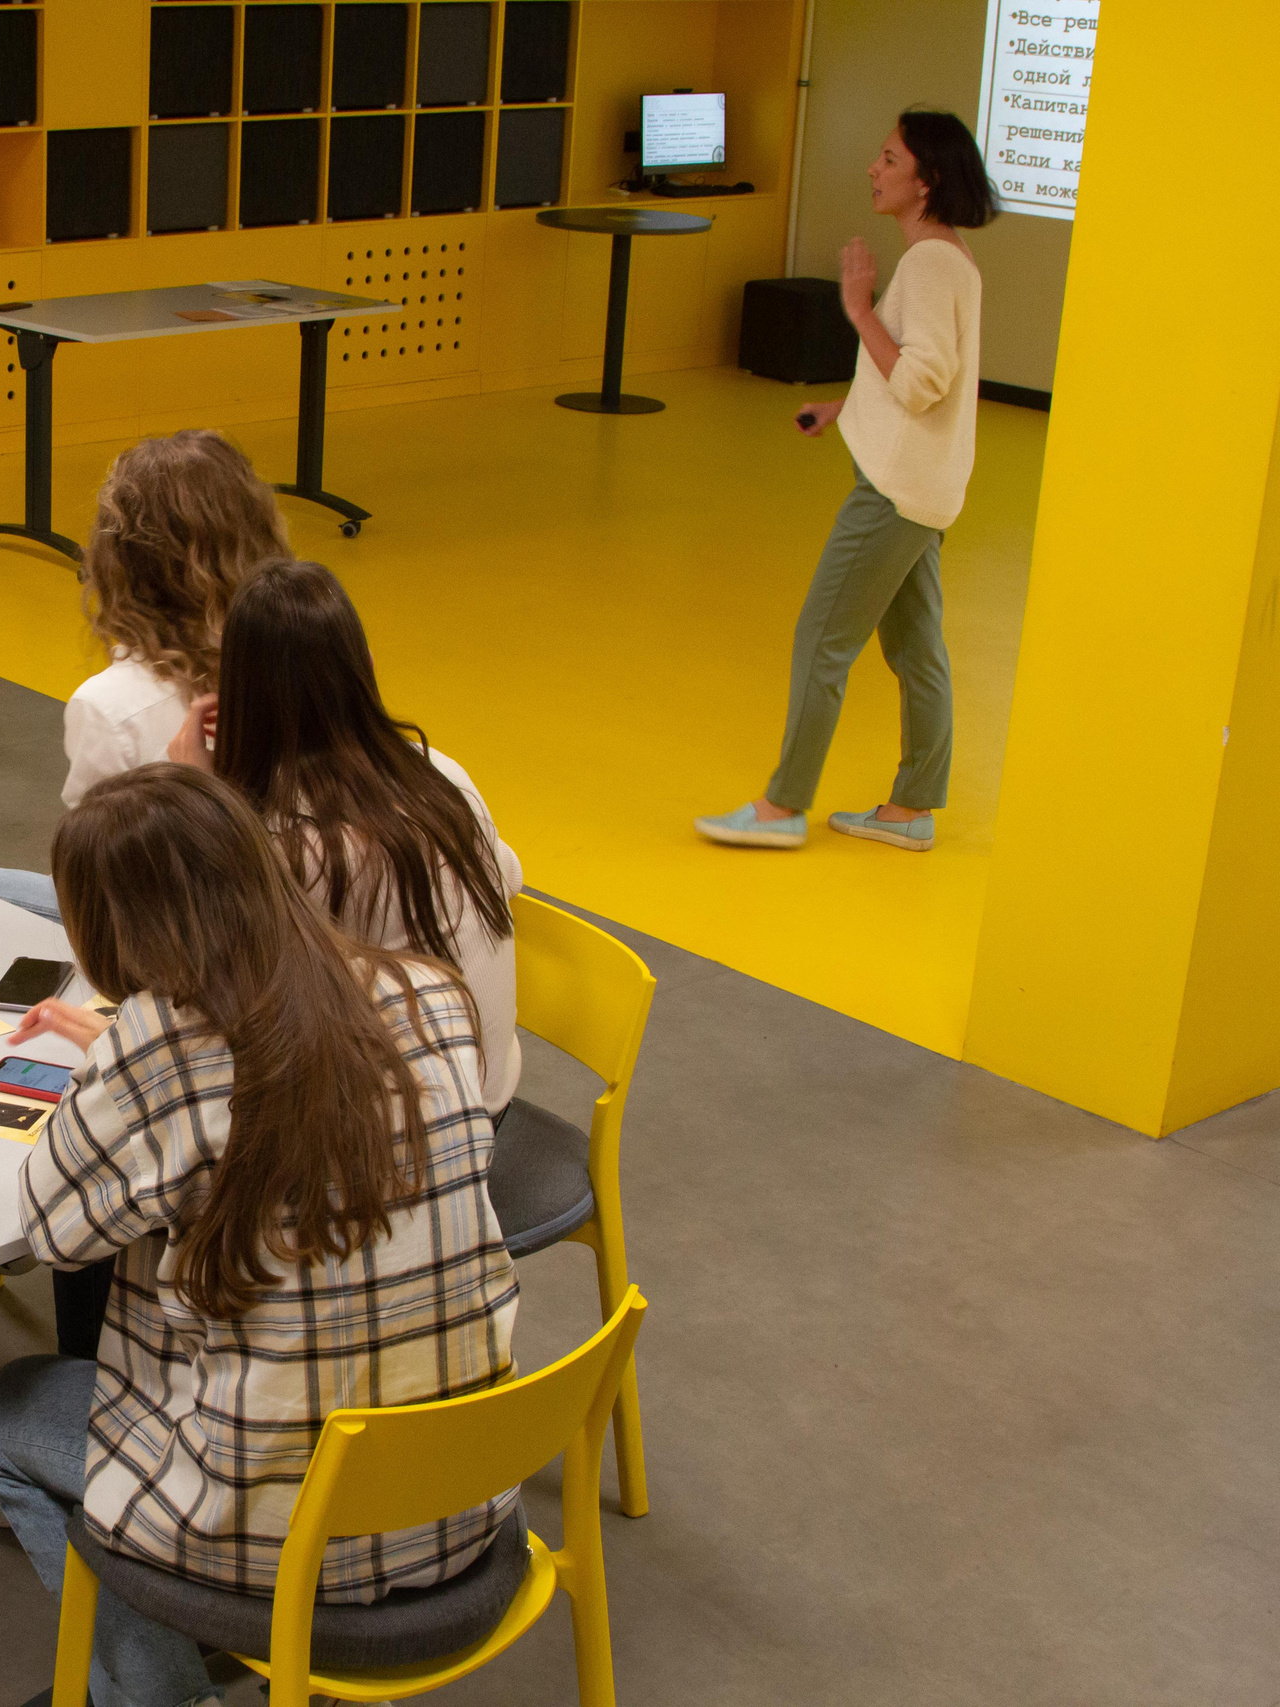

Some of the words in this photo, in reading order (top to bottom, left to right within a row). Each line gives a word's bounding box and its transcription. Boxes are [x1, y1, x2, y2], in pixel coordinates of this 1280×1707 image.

[1017, 10, 1052, 27] Все
[1013, 69, 1071, 86] одной
[1004, 149, 1051, 169] Если
[1002, 179, 1025, 193] он
